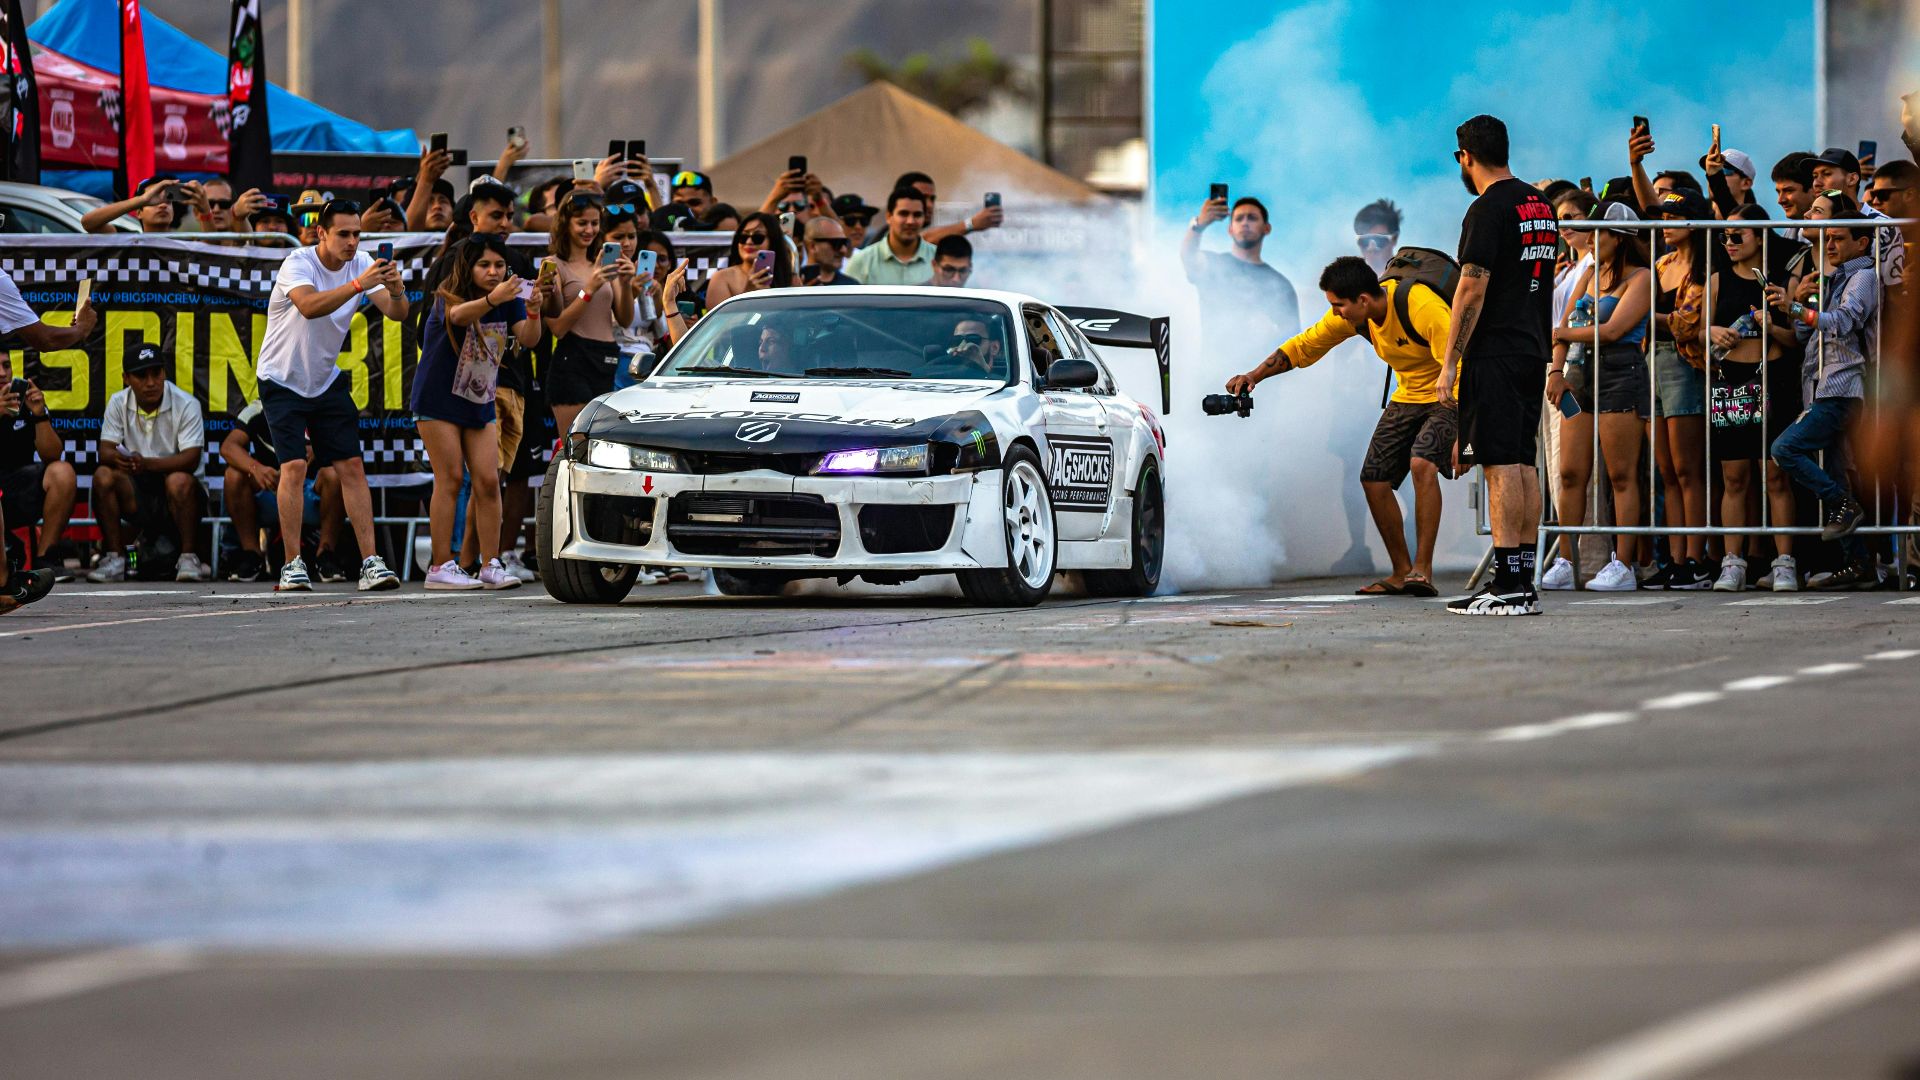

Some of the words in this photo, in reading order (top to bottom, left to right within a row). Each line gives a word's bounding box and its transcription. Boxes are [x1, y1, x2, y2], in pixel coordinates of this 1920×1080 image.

[113, 292, 200, 305] @BIGSPINCREW
[10, 310, 268, 412] SPIN
[1069, 490, 1107, 502] PERFORMANCE
